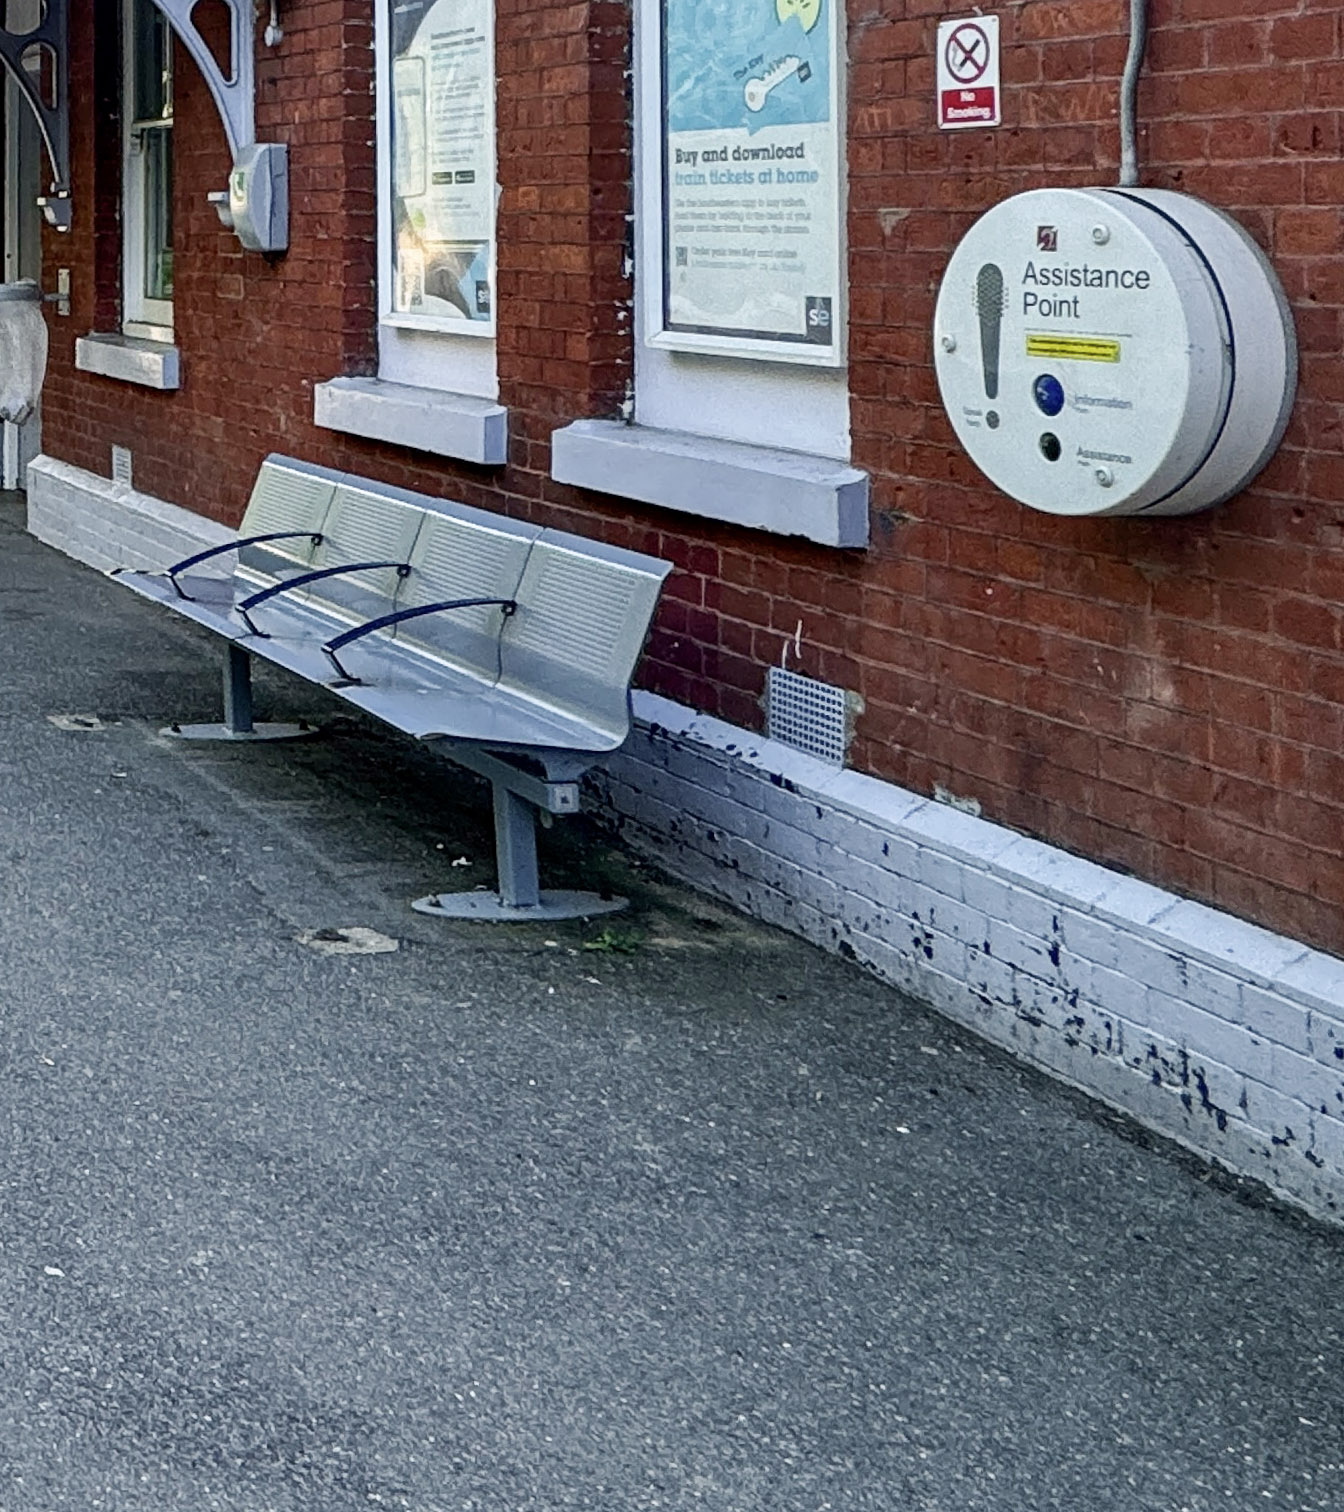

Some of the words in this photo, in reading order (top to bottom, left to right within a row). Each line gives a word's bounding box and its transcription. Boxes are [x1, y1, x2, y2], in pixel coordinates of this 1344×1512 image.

[959, 92, 976, 102] No
[946, 106, 992, 119] Smoking
[675, 148, 698, 167] Buy
[701, 146, 728, 163] and
[732, 142, 805, 160] download
[674, 172, 707, 186] train
[710, 169, 755, 185] tickets
[758, 168, 772, 185] at
[776, 168, 820, 184] home
[1021, 261, 1150, 289] Assistance
[1023, 292, 1080, 318] Point
[1074, 392, 1133, 410] Information
[1076, 445, 1132, 464] Assistance
